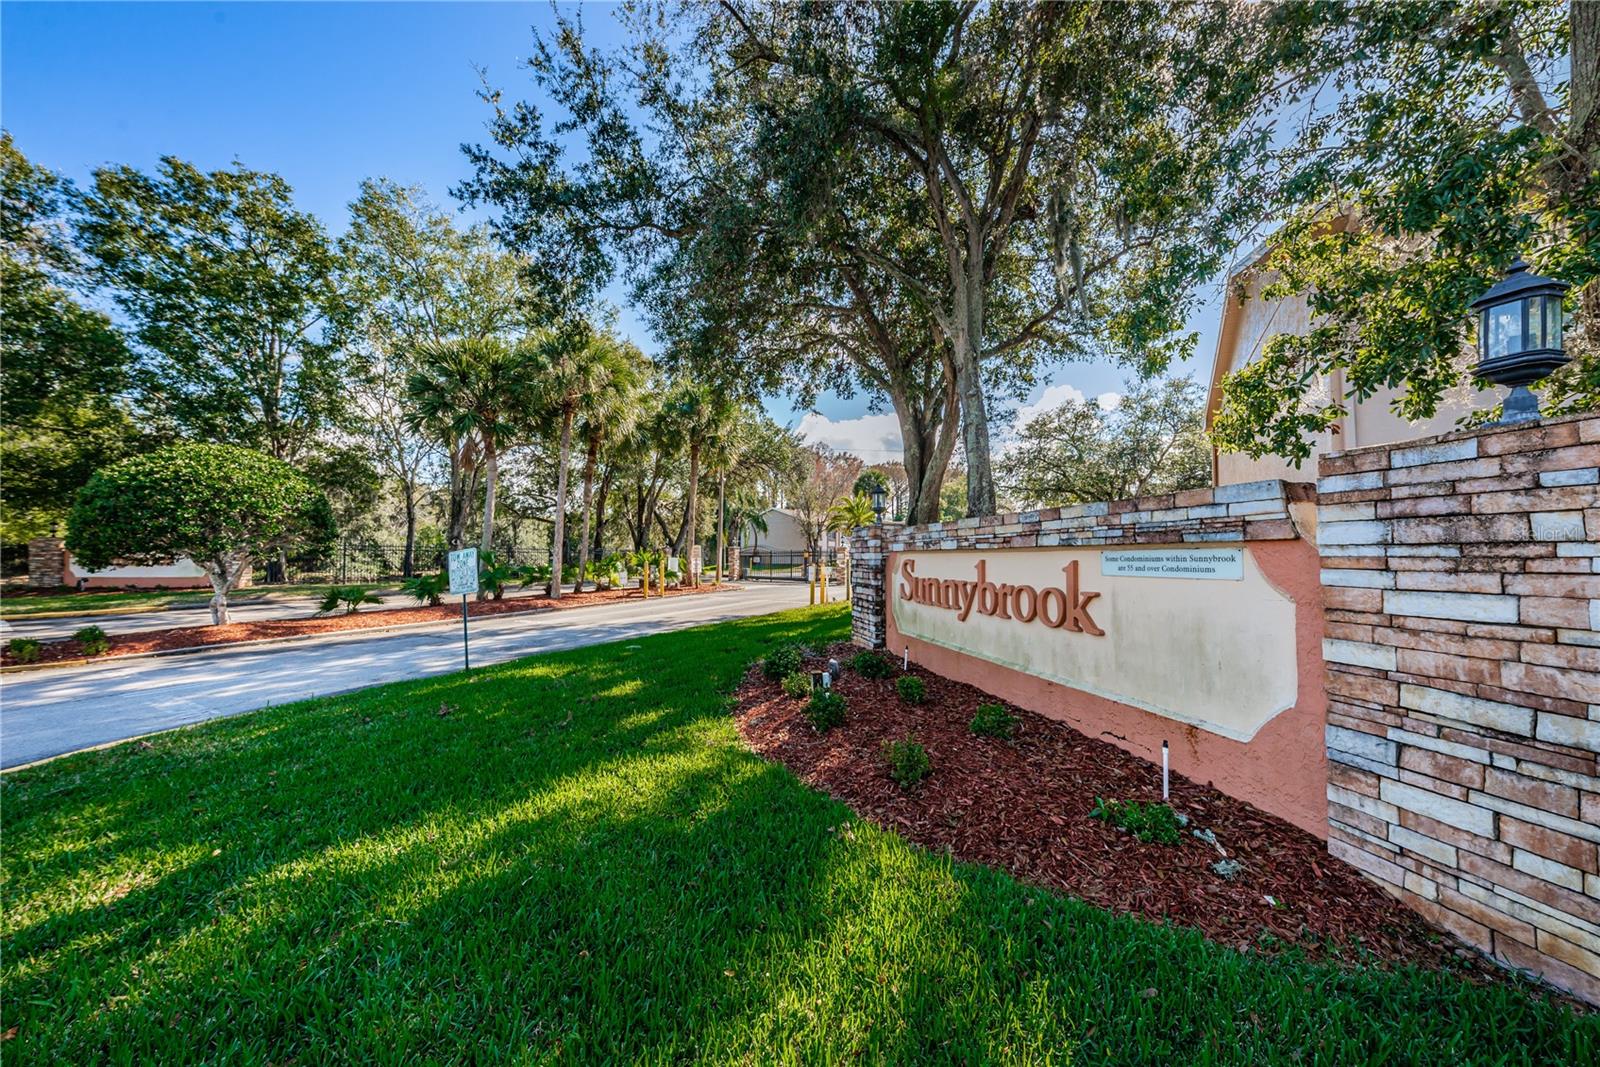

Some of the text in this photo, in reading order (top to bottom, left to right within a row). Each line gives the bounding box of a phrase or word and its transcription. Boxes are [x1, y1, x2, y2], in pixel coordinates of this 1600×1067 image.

[1120, 555, 1164, 563] Condominiums
[1165, 555, 1187, 563] within
[1189, 554, 1236, 565] Sunnybrook
[1161, 565, 1216, 574] Condominiums
[901, 559, 1105, 637] Sunnybrook
